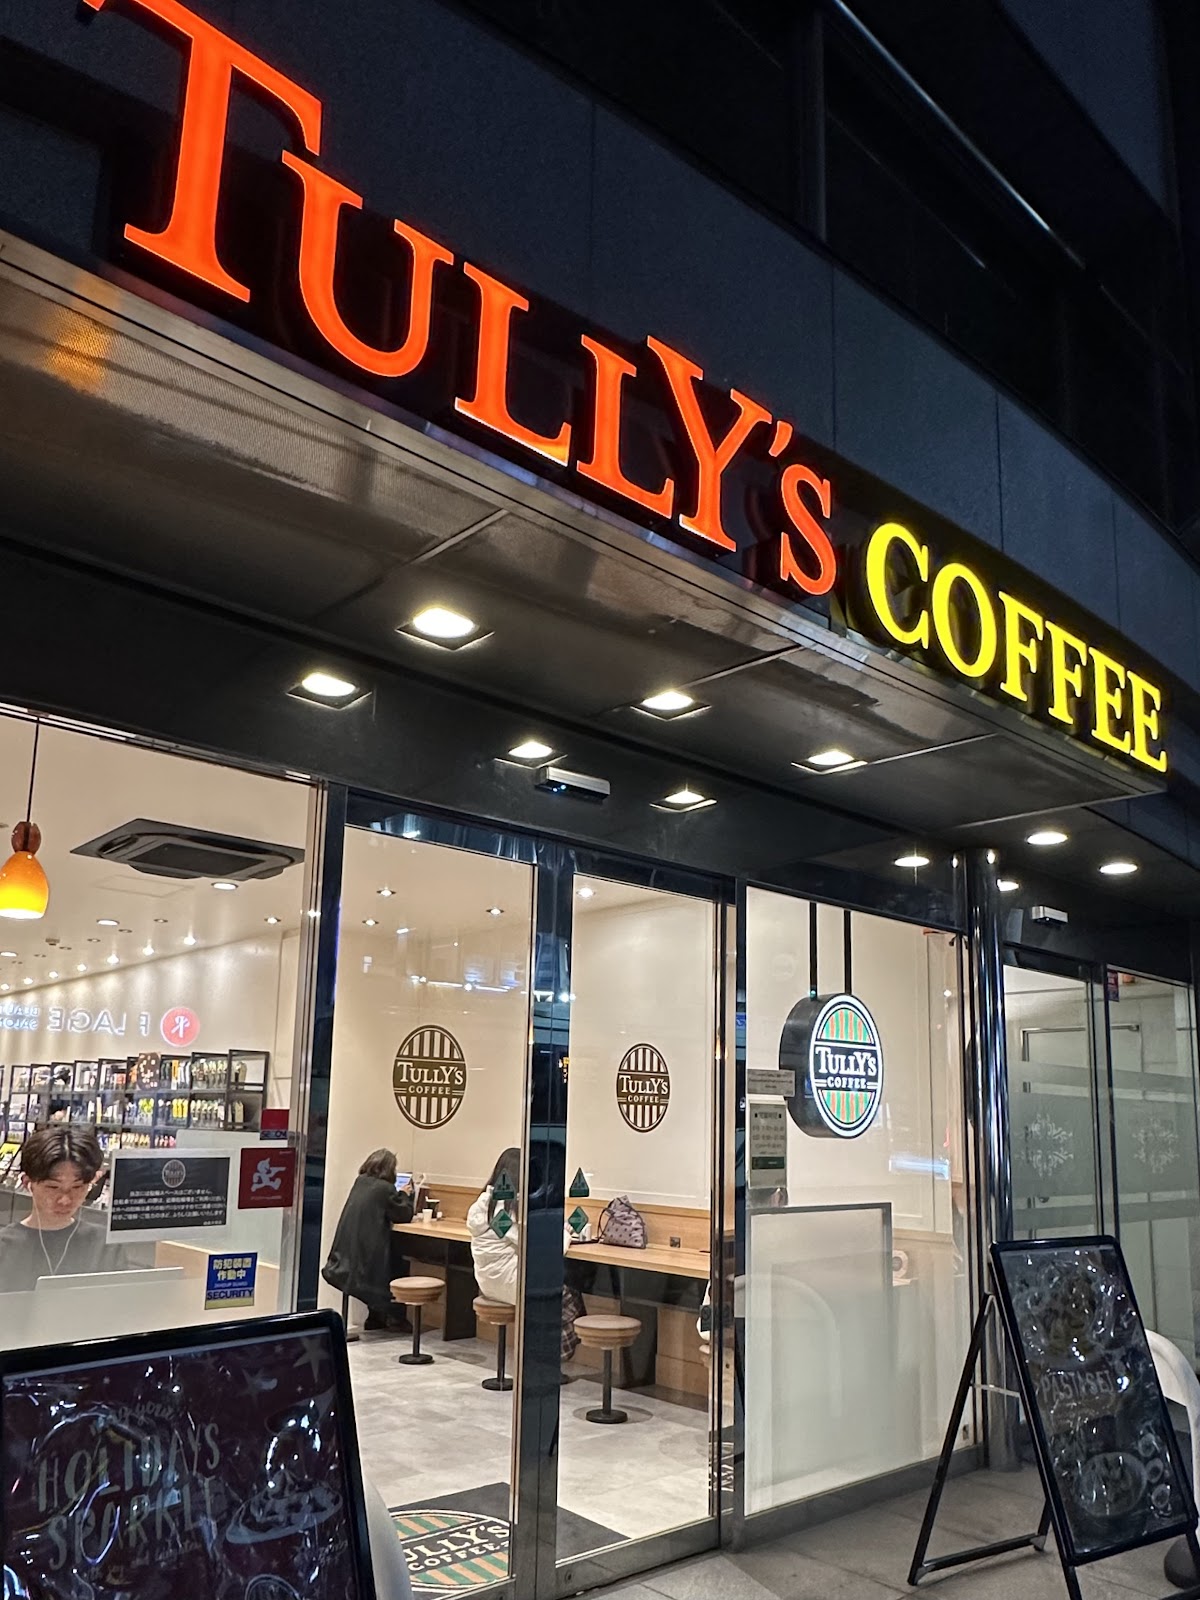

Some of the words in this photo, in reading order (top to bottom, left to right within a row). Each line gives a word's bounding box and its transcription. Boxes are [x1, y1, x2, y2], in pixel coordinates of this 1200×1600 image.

[80, 0, 838, 596] TULLY'S
[865, 522, 1168, 773] COFFEE
[815, 1047, 877, 1076] TULLY'S
[397, 1062, 464, 1085] TULLY'S
[619, 1075, 668, 1095] TULLY'S
[827, 1077, 867, 1089] COFFEE
[408, 1085, 451, 1095] COFFEE
[627, 1095, 660, 1103] COFFEE
[206, 1289, 253, 1300] SECURITY
[38, 1423, 220, 1512] HOLIDAYS
[403, 1525, 510, 1562] ULLY'S
[408, 1542, 500, 1571] COFFEE
